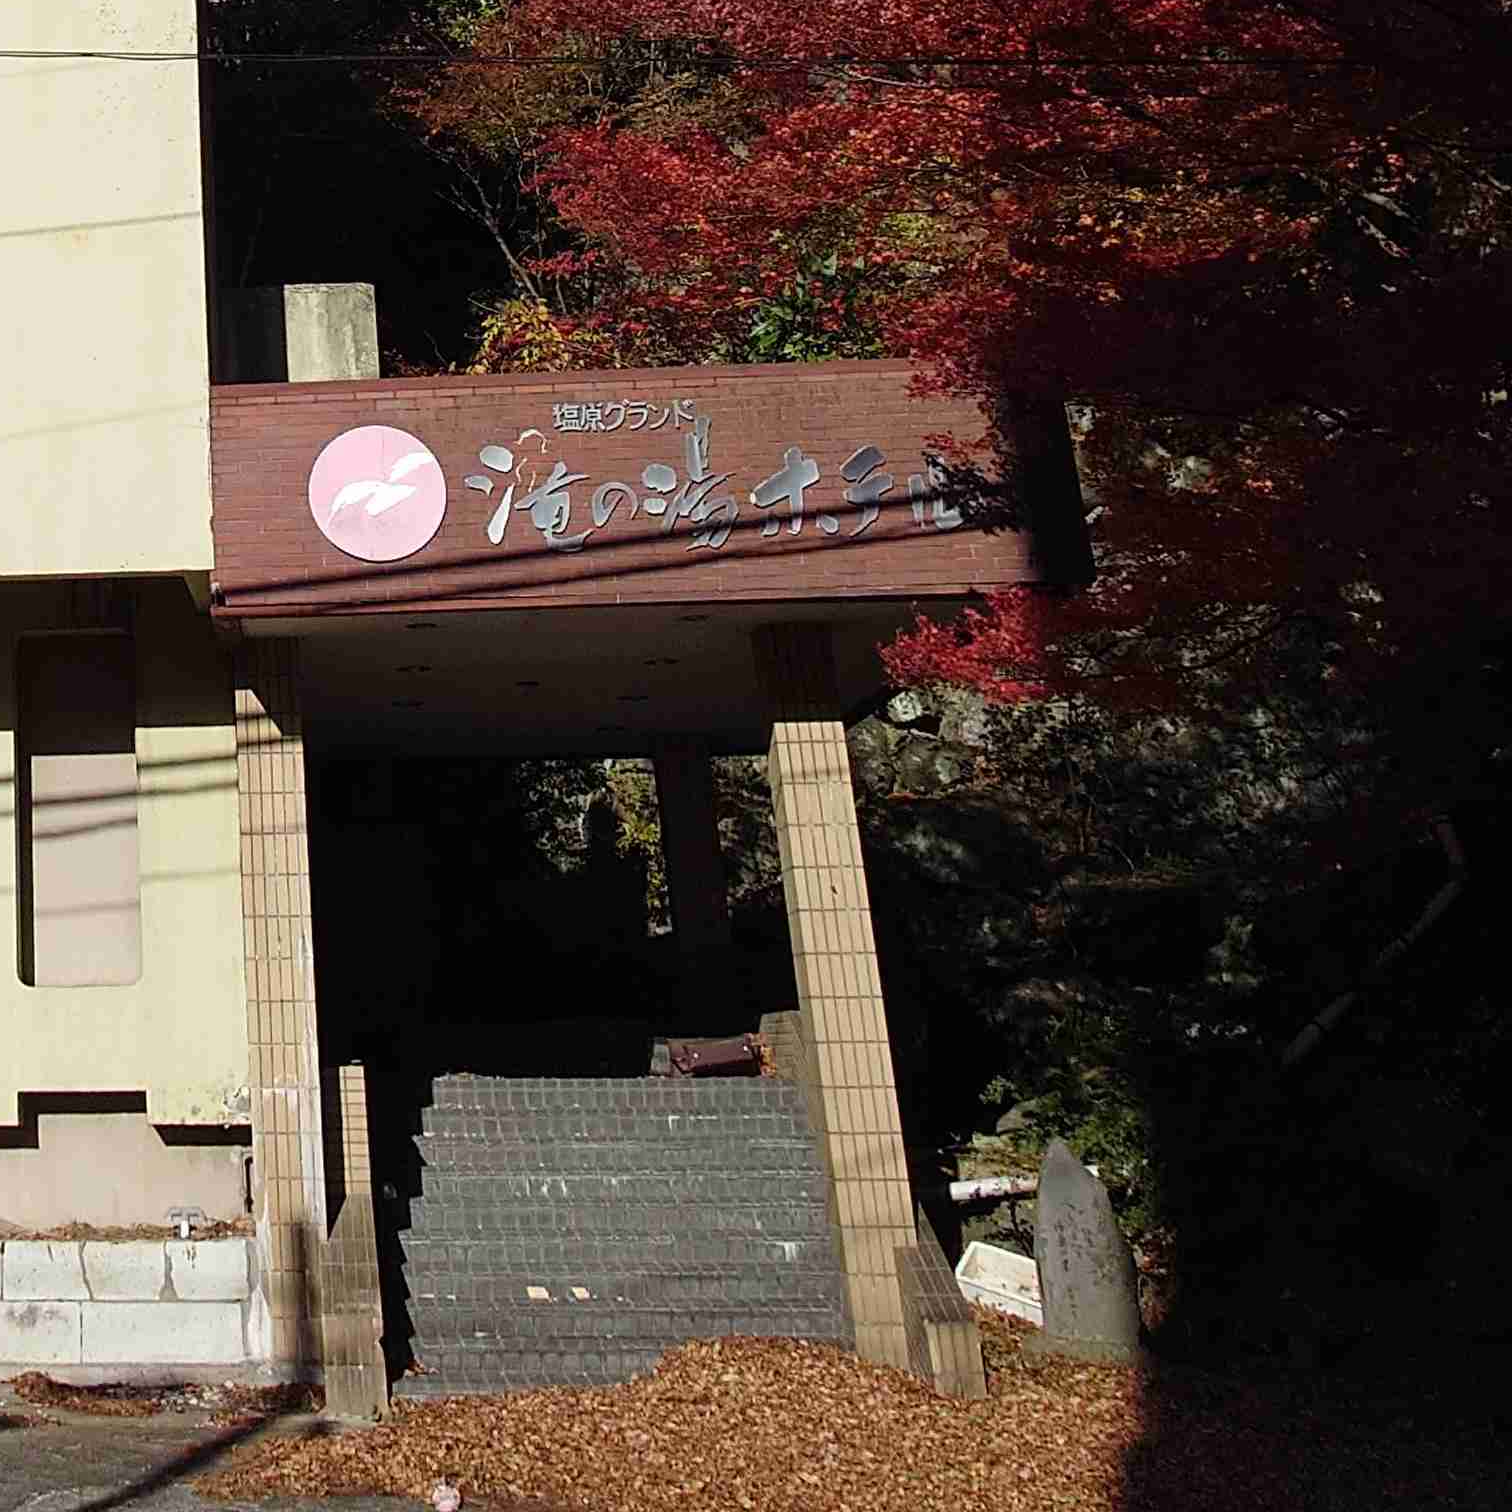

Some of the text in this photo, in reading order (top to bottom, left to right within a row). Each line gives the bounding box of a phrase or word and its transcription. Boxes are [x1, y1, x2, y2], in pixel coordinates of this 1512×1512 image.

[552, 398, 696, 433] 塩原グランド
